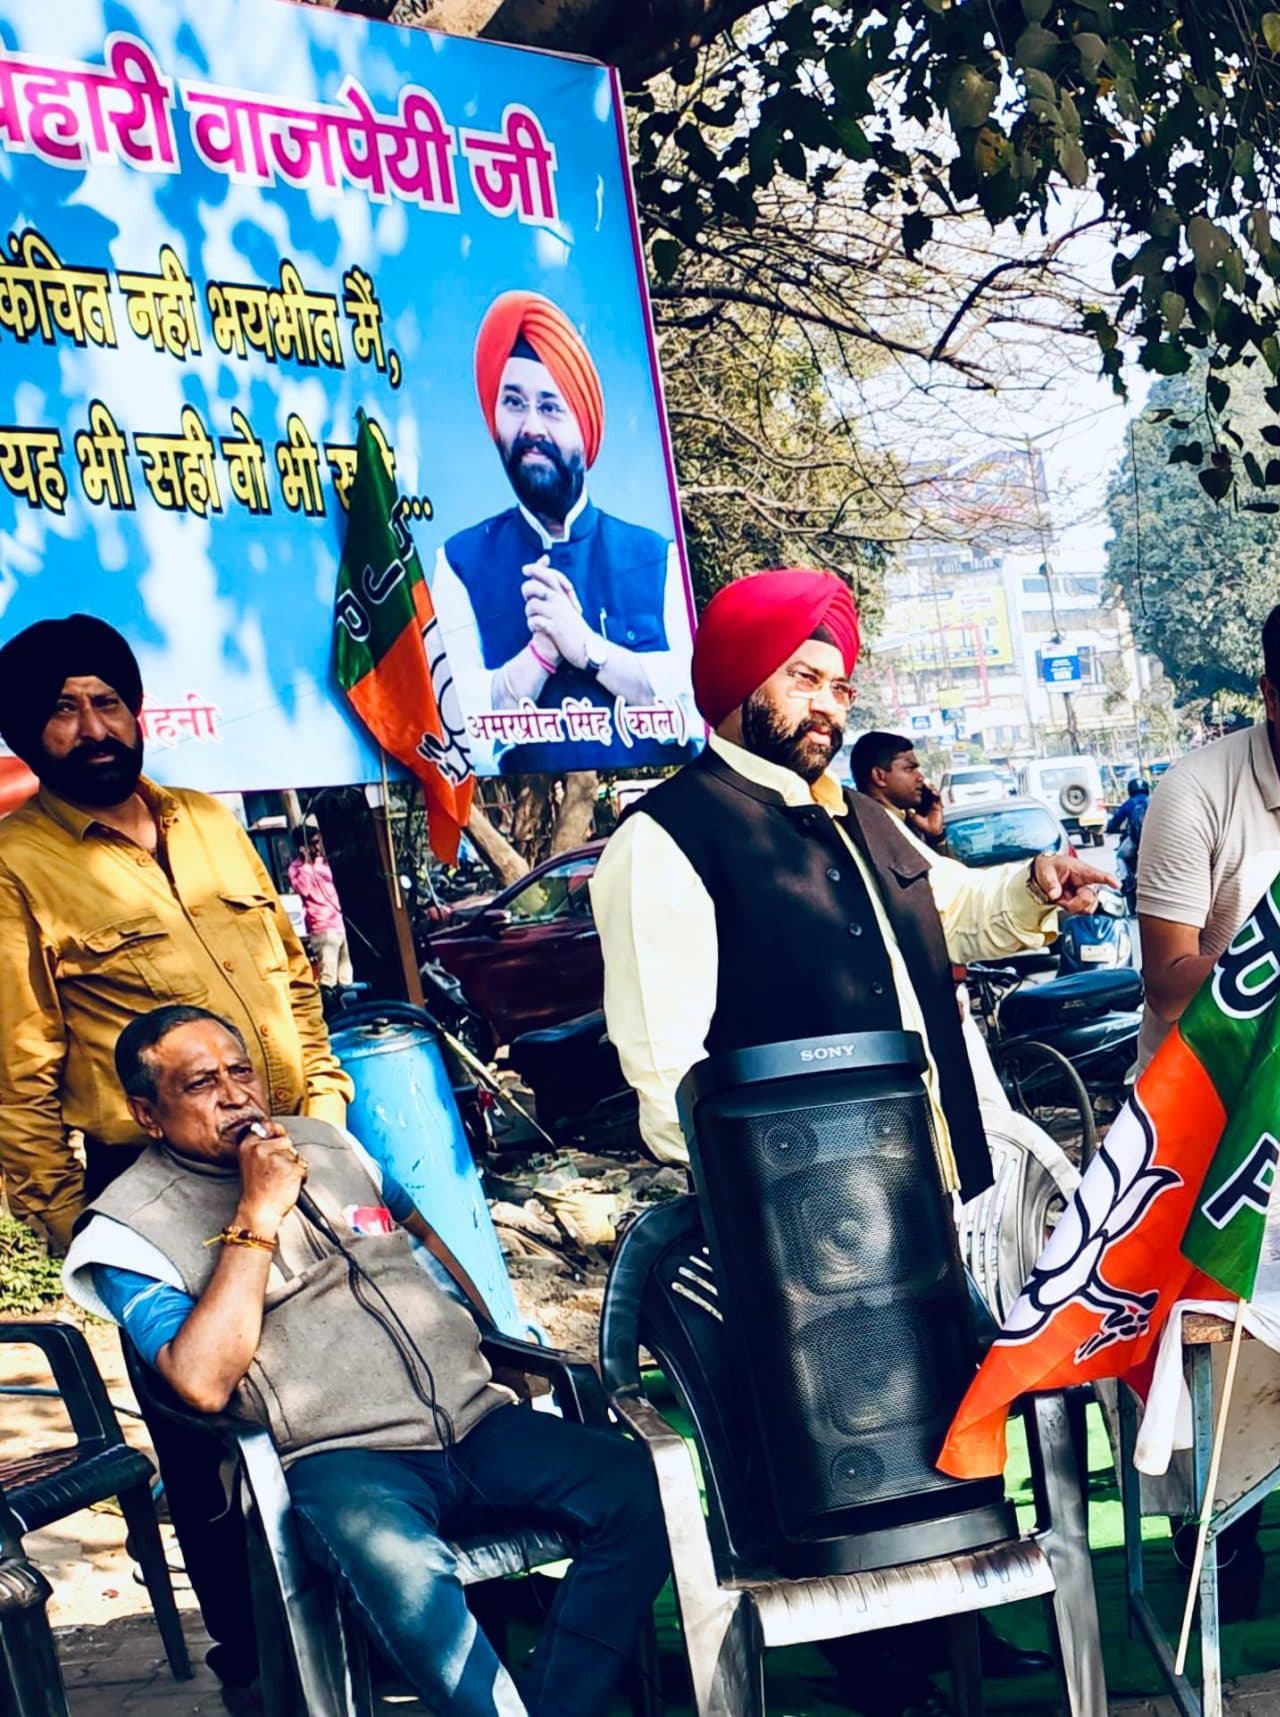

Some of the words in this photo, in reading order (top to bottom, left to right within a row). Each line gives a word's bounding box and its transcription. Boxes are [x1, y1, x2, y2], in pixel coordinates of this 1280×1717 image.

[0, 38, 175, 166] हारी
[184, 84, 458, 208] वाजपेयी
[464, 110, 556, 220] जी
[115, 243, 202, 362] नही
[206, 258, 345, 370] भयभीत
[0, 425, 66, 515] यह
[74, 398, 136, 510] भी
[133, 403, 223, 519] सही
[219, 406, 272, 515] वो
[275, 413, 326, 516] भी
[467, 701, 562, 741] अमरप्रीत
[564, 700, 611, 744] सिंह
[799, 1044, 856, 1062] SONY
